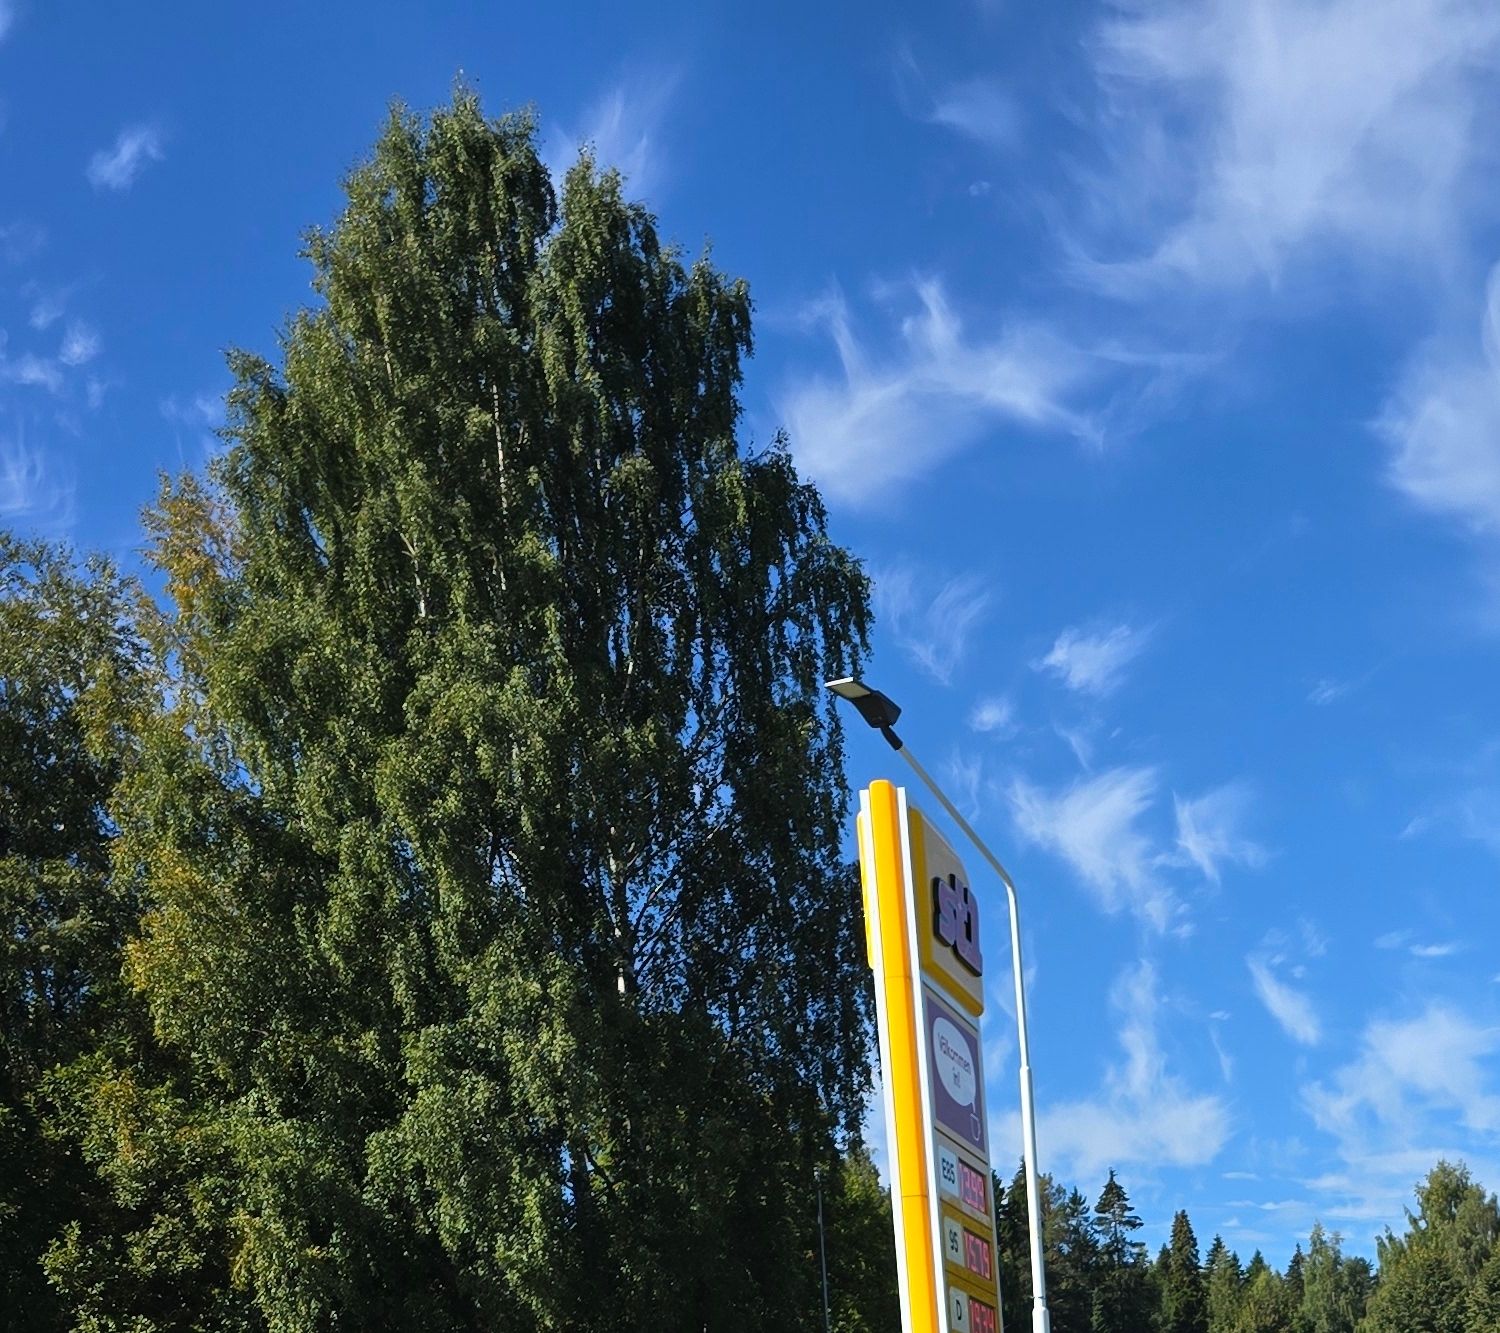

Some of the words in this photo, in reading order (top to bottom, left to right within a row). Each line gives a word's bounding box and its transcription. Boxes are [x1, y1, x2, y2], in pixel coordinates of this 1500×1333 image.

[942, 1157, 955, 1184] E85
[949, 1229, 958, 1252] 95
[956, 1299, 962, 1320] D
